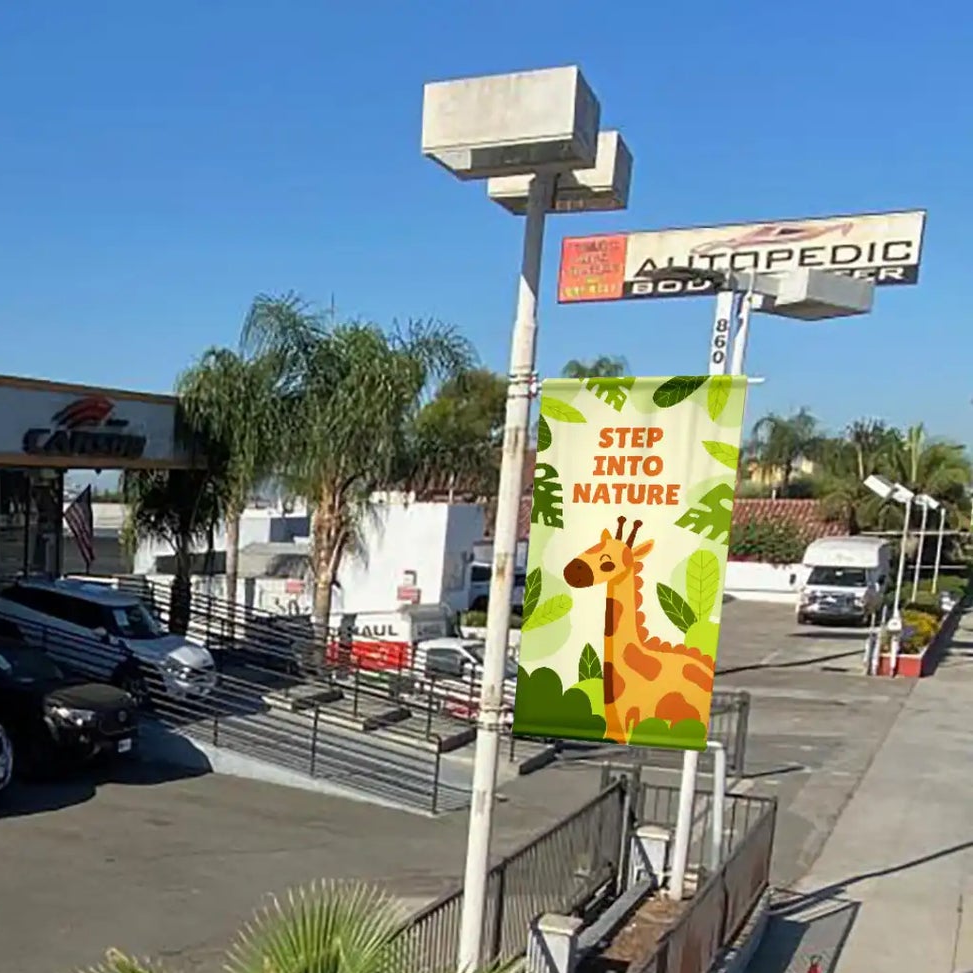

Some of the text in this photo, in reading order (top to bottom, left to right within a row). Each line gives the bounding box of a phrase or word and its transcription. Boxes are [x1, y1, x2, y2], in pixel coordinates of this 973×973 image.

[631, 279, 713, 295] BOD
[713, 318, 728, 364] 860
[598, 427, 664, 449] STEP
[592, 455, 664, 477] INTO
[572, 483, 681, 505] NATURE
